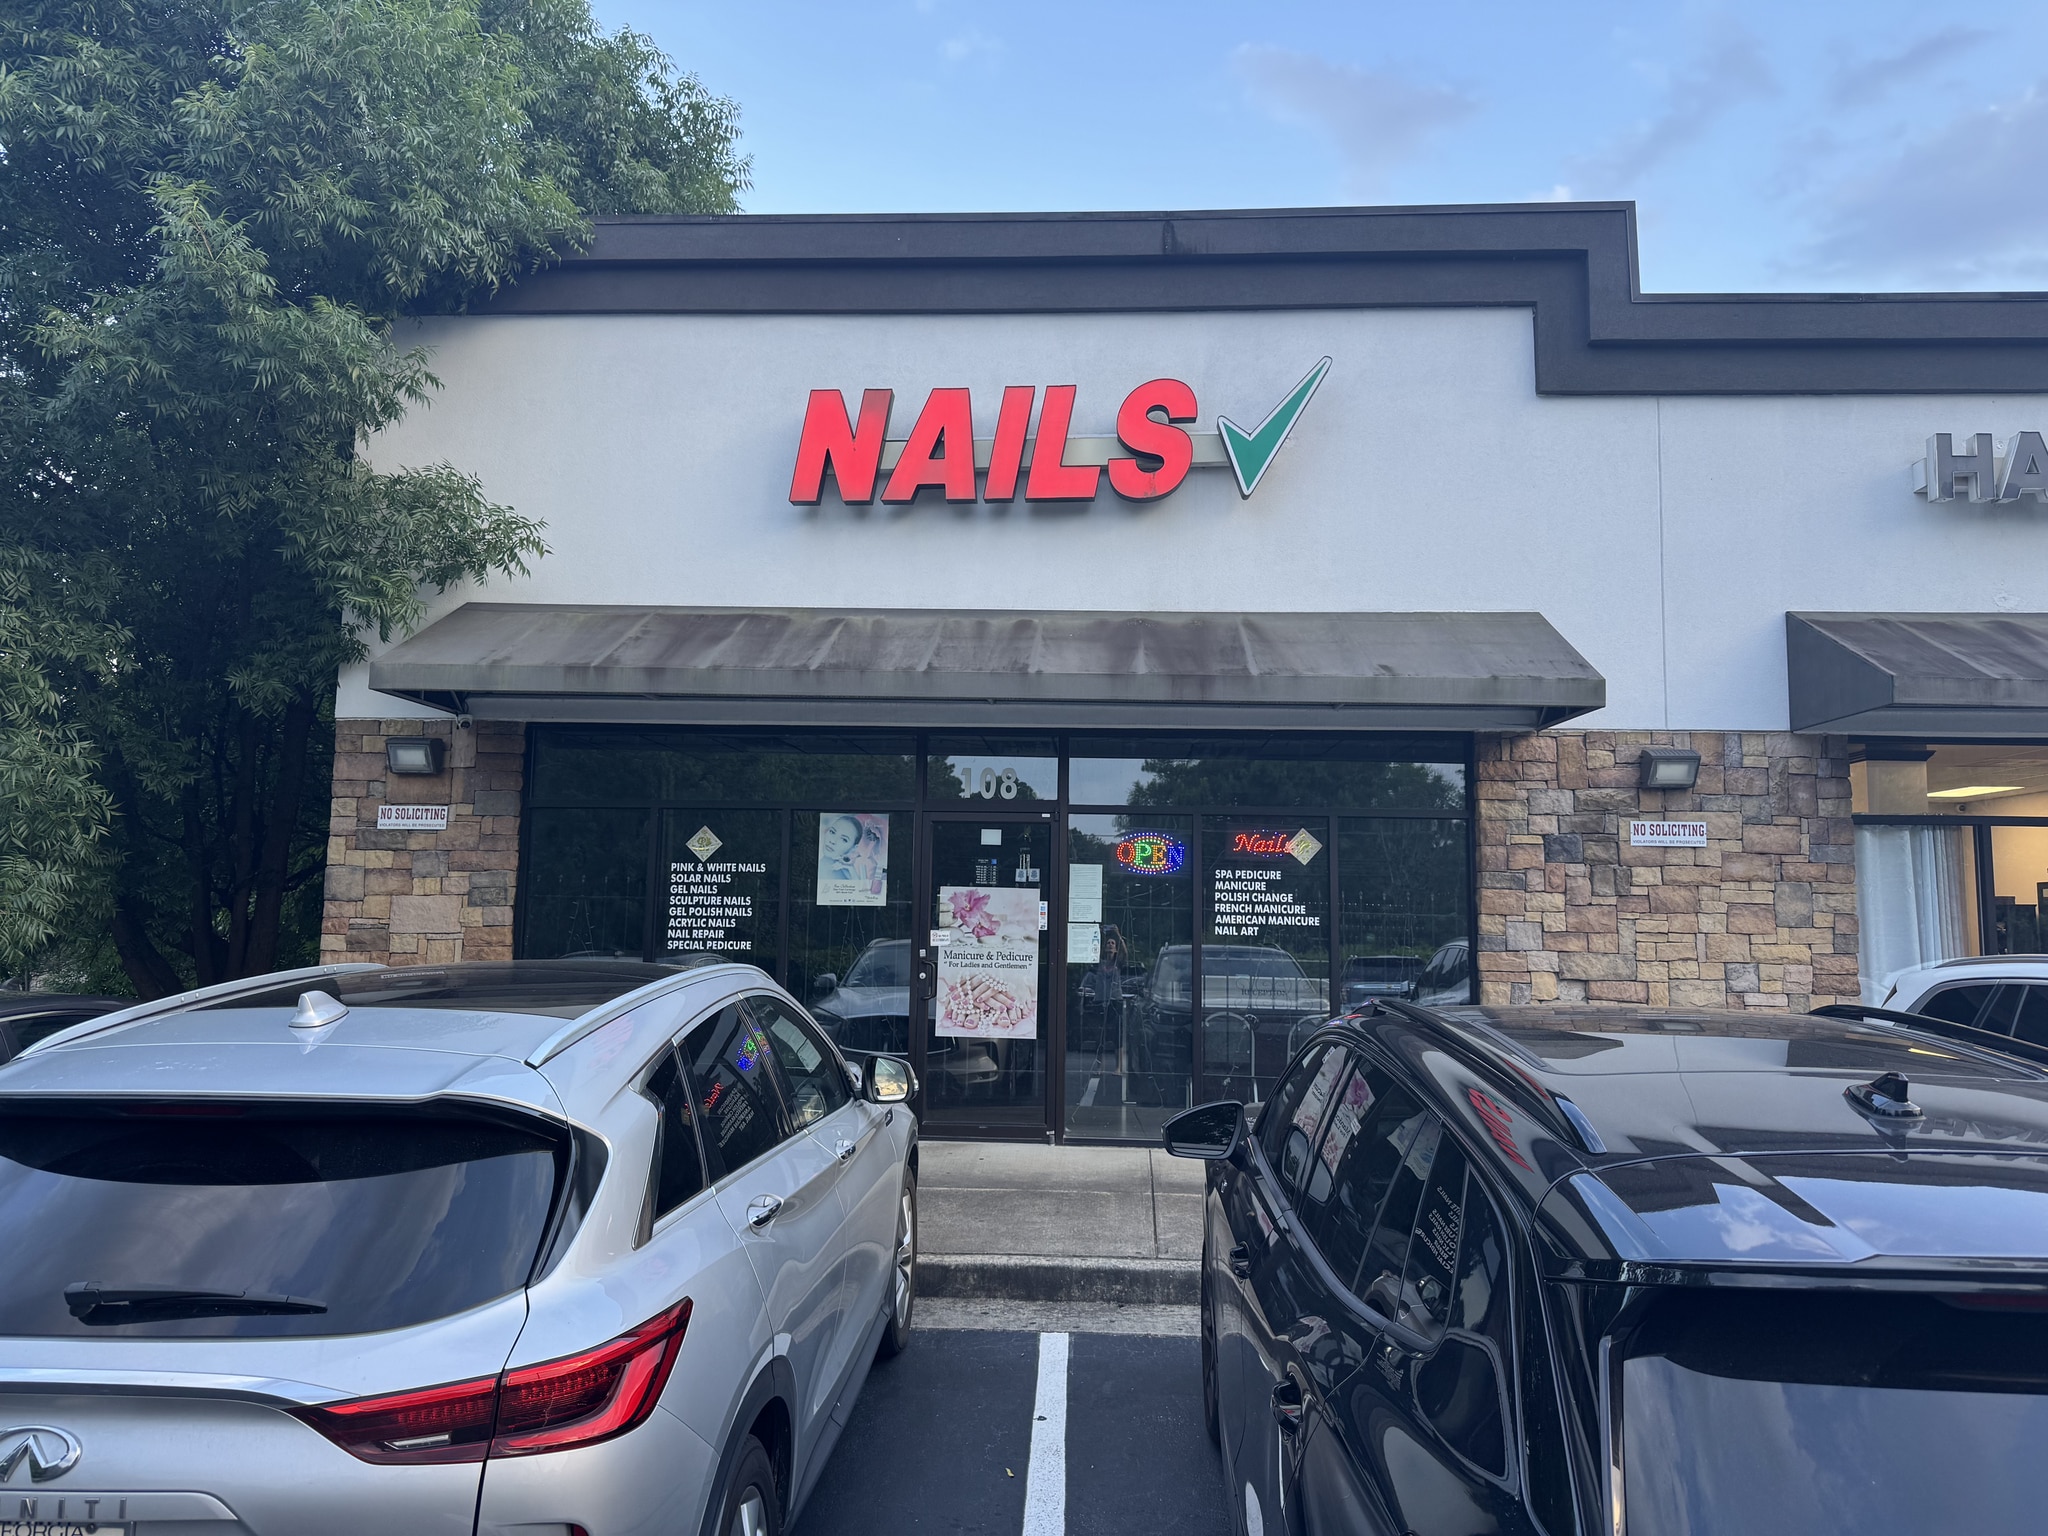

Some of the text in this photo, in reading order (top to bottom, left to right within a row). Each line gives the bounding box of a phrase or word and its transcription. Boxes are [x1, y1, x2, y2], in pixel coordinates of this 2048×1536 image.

[788, 377, 1199, 504] NAILS
[1930, 431, 2048, 501] HA
[960, 767, 1018, 800] 108
[380, 807, 446, 821] NO SOLICITING
[1633, 823, 1705, 837] NO SOLICITING
[1116, 841, 1185, 866] OPEN
[671, 862, 767, 873] PINK & WHITE NAILS
[670, 873, 732, 883] SOLAR NAILS
[1215, 869, 1282, 880] SPA PEDICURE
[670, 884, 718, 894] GEL NAILS
[1215, 881, 1267, 891] MANICURE
[669, 895, 752, 906] SCULPTURE NAILS
[1214, 892, 1294, 903] POLISH CHANGE
[669, 907, 753, 917] GEL POLISH NAILS
[1214, 903, 1306, 914] FRENCH MANICURE
[668, 918, 736, 928] ACRYLIC NAILS
[1215, 914, 1320, 926] AMERICAN MANICURE
[667, 929, 725, 939] NAIL REPAIR
[1214, 926, 1259, 936] NAIL ART
[667, 940, 752, 950] SPECIAL PEDICURE
[943, 950, 1034, 962] Manicure & Pedicure
[993, 962, 1028, 970] Gentlemen
